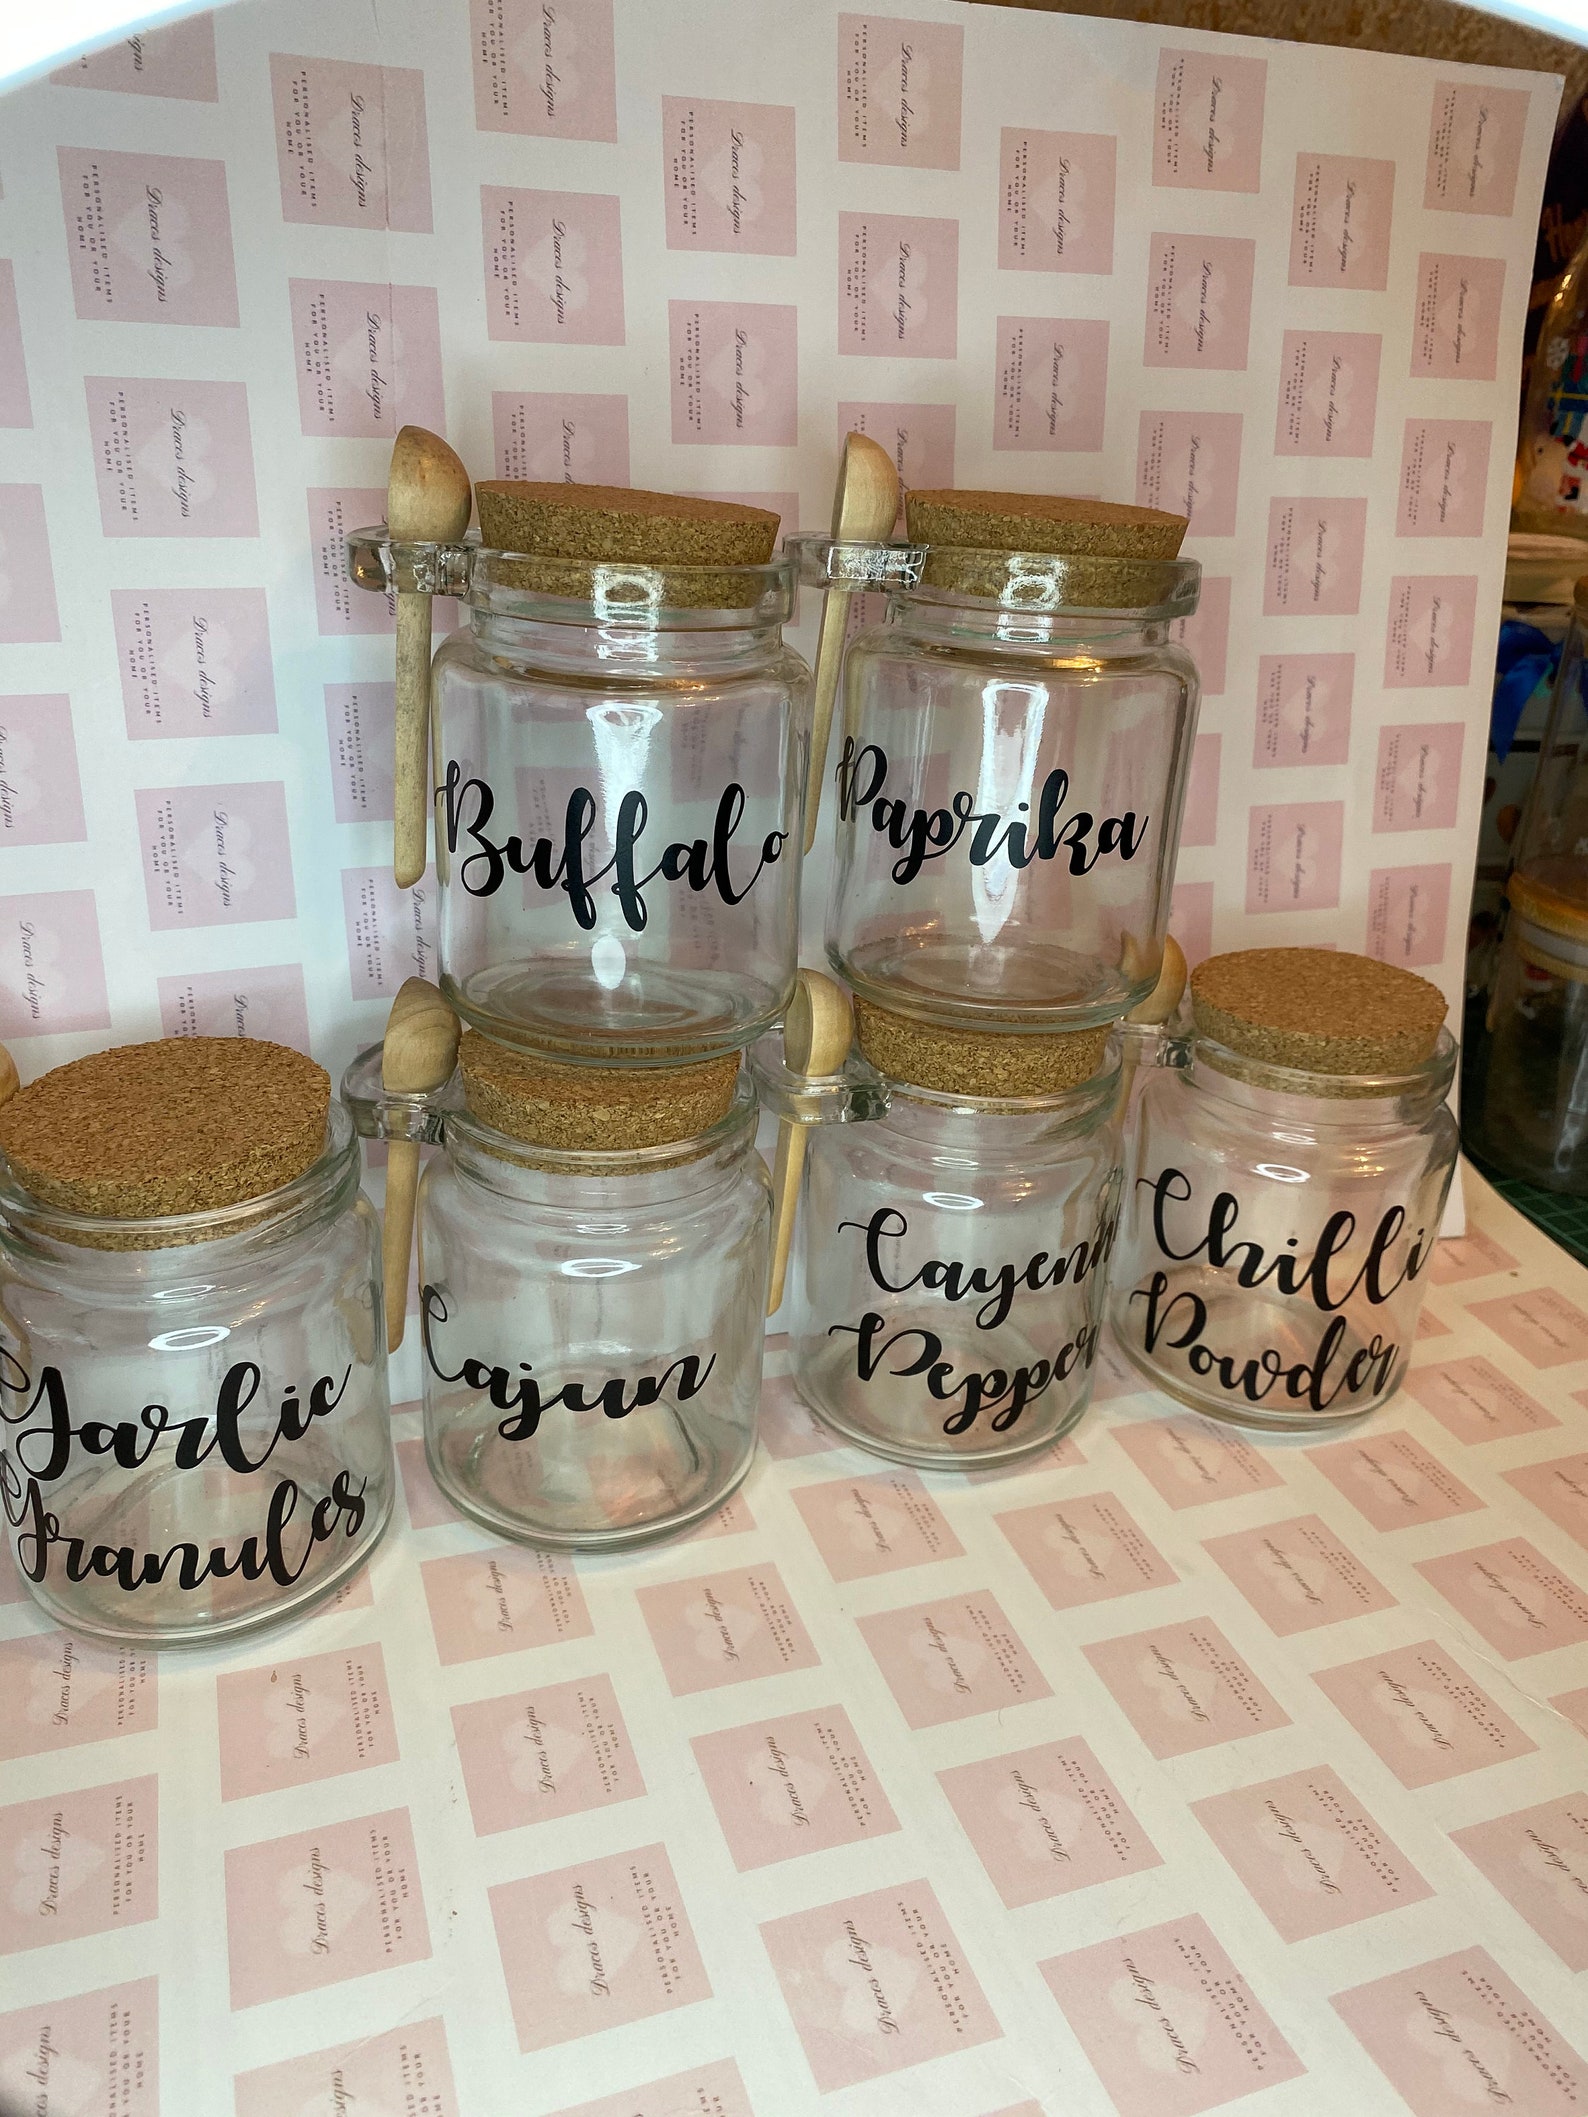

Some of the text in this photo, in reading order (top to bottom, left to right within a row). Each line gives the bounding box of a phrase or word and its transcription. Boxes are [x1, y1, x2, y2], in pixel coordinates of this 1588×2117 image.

[291, 80, 299, 103] FOR
[539, 63, 562, 117] designs
[285, 121, 295, 154] HOME
[294, 111, 302, 135] YOU
[894, 98, 915, 148] designs
[81, 174, 91, 198] FOR
[299, 165, 307, 196] YOUR
[308, 171, 318, 207] ITEMS
[349, 153, 373, 208] designs
[85, 206, 94, 230] YOU
[726, 184, 748, 234] designs
[76, 216, 87, 250] HOME
[1052, 208, 1071, 255] designs
[92, 260, 102, 292] YOUR
[147, 247, 173, 303] designs
[493, 247, 501, 278] HOME
[102, 266, 114, 303] ITEMS
[549, 274, 571, 325] designs
[512, 293, 520, 326] ITEMS
[892, 293, 912, 340] designs
[365, 368, 388, 420] designs
[729, 381, 750, 428] designs
[171, 466, 196, 518] designs
[134, 612, 142, 633] FOR
[128, 649, 138, 679] HOME
[137, 639, 145, 661] YOU
[142, 687, 152, 715] YOUR
[152, 691, 162, 724] ITEMS
[193, 670, 217, 718] designs
[835, 736, 1150, 885] Paprika
[434, 759, 789, 932] Buffalo
[213, 861, 237, 907] designs
[410, 935, 432, 978] designs
[21, 972, 46, 1020] designs
[1135, 1168, 1434, 1311] Chilli
[1129, 1271, 1400, 1411] Powder
[419, 1284, 717, 1441] Cajun
[828, 1312, 1097, 1435] Pepper
[0, 1345, 352, 1481] Garlic
[0, 1449, 367, 1592] Granules
[52, 1641, 80, 1681] designs
[285, 1673, 312, 1713] designs
[1376, 1670, 1416, 1708] designs
[522, 1705, 548, 1746] designs
[763, 1735, 790, 1778] designs
[114, 1794, 124, 1827] ITEMS
[1009, 1770, 1042, 1813] designs
[126, 1800, 135, 1829] YOUR
[1263, 1799, 1303, 1843] designs
[39, 1811, 71, 1861] designs
[137, 1833, 146, 1863] HOME
[369, 1828, 380, 1861] ITEMS
[381, 1835, 392, 1863] YOUR
[1525, 1829, 1571, 1872] designs
[125, 1854, 134, 1876] YOU
[302, 1847, 331, 1897] designs
[397, 1868, 409, 1899] HOME
[629, 1865, 645, 1899] ITEMS
[123, 1881, 132, 1902] FOR
[389, 1889, 399, 1912] YOU
[642, 1872, 657, 1901] YOUR
[393, 1918, 403, 1940] FOR
[570, 1884, 598, 1936] designs
[664, 1905, 680, 1937] HOME
[660, 1928, 672, 1951] YOU
[842, 1920, 874, 1972] designs
[669, 1957, 682, 1980] FOR
[1121, 1958, 1162, 2011] designs
[1414, 1992, 1463, 2043] designs
[25, 2025, 60, 2086] designs
